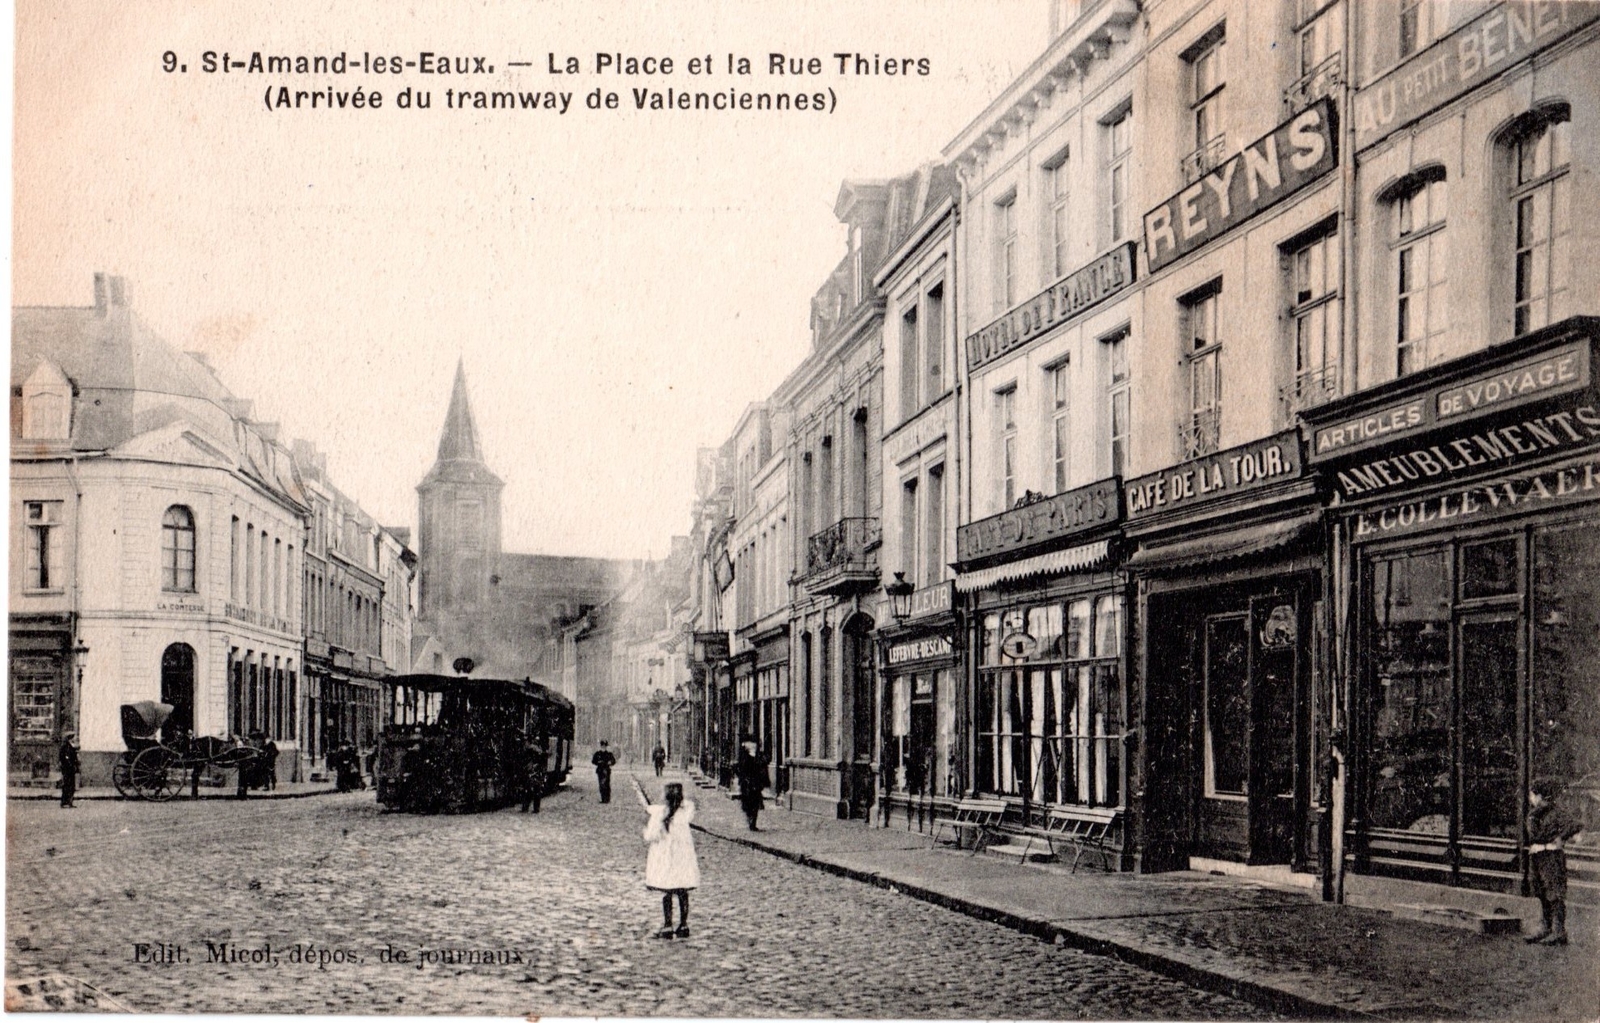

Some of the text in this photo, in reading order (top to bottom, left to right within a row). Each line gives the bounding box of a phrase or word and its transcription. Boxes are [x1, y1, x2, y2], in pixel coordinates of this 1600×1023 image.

[1145, 109, 1325, 261] REYNS
[1047, 253, 1124, 323] FRANCE
[1318, 358, 1576, 450] ARTICLES DE VOYAGE
[1129, 445, 1293, 512] CAFÉ DE LA TOUR.
[1337, 405, 1600, 495] AMEUBLEMENTS
[1048, 489, 1108, 533] PARIS
